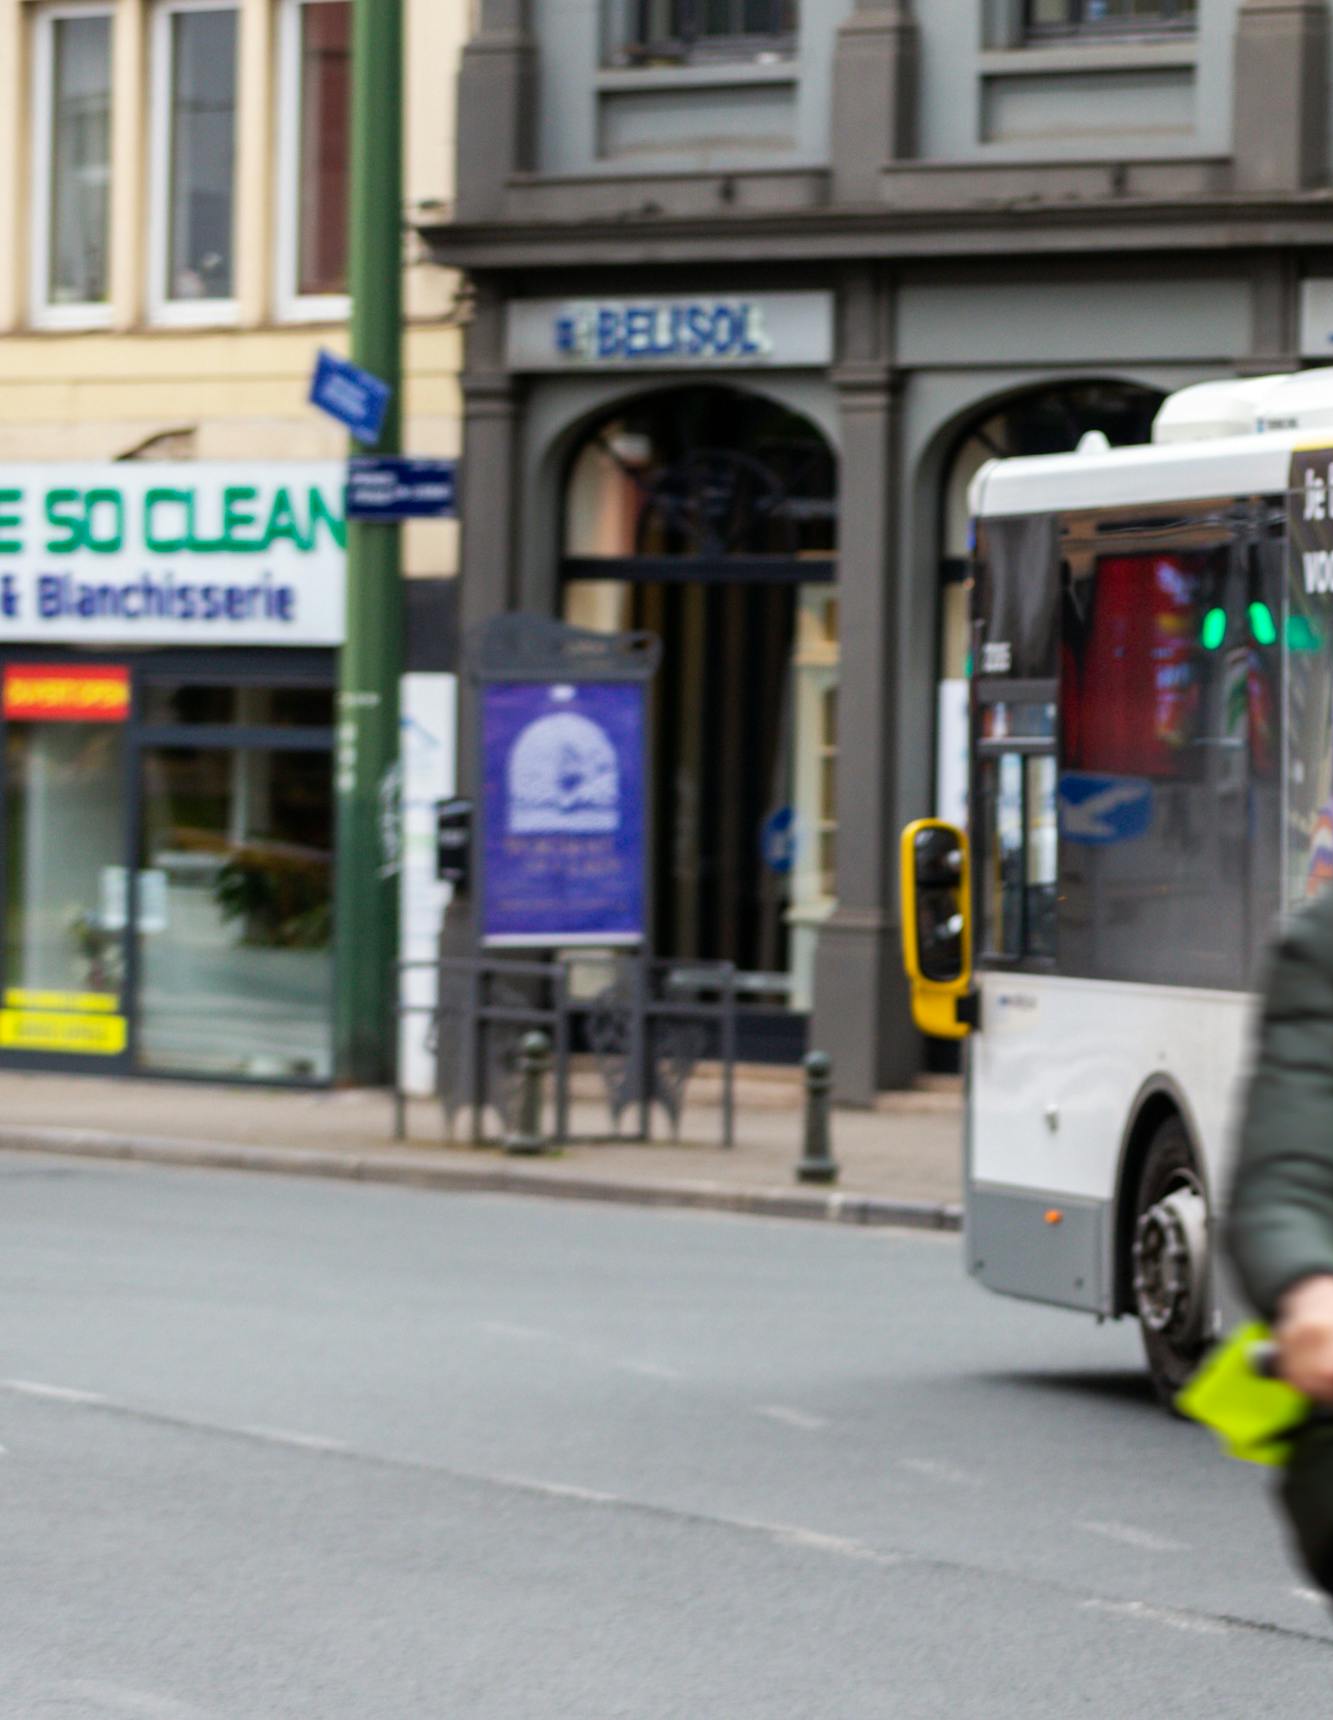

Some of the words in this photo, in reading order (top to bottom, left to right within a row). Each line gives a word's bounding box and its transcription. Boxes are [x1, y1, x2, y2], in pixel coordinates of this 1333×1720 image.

[598, 303, 762, 357] BELISOL
[45, 487, 123, 553] SO
[145, 486, 349, 553] CLEAN
[1304, 468, 1325, 520] Je
[38, 570, 295, 622] Blanchisserie
